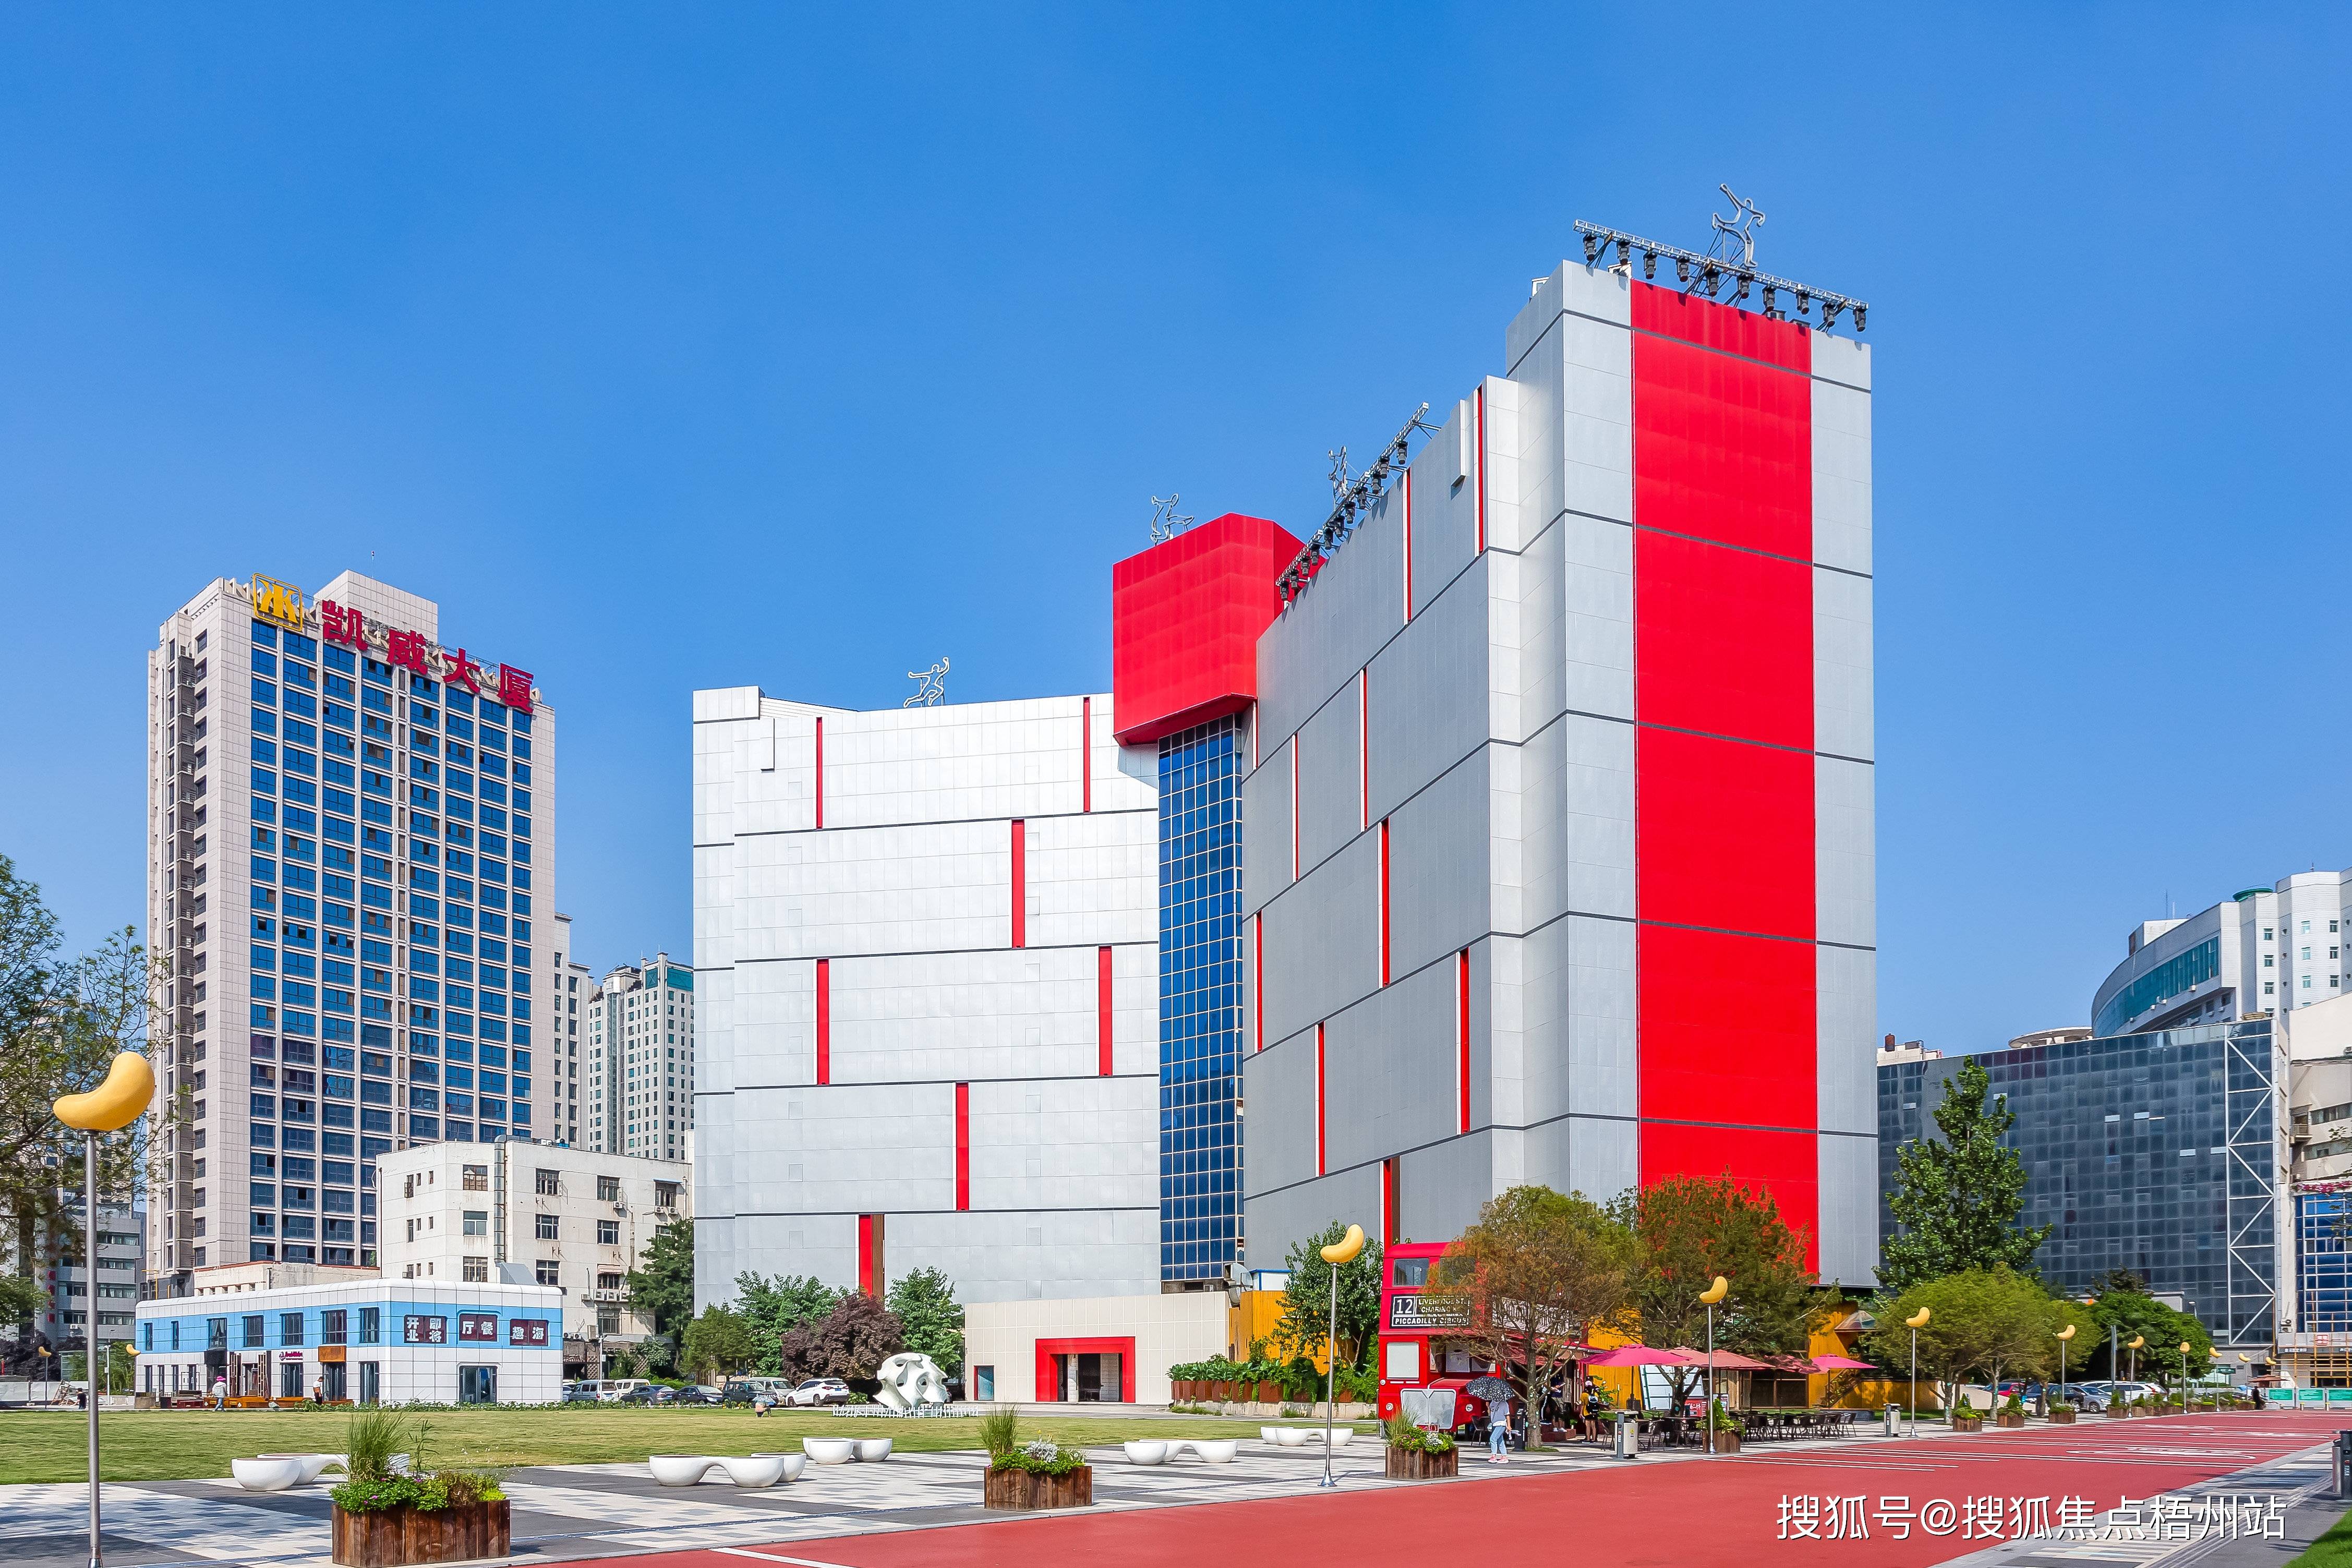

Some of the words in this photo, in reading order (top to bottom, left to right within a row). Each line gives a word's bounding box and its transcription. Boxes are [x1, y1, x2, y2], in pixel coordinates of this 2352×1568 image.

[322, 599, 534, 713] 凯威大厦
[1396, 1299, 1413, 1314] 12
